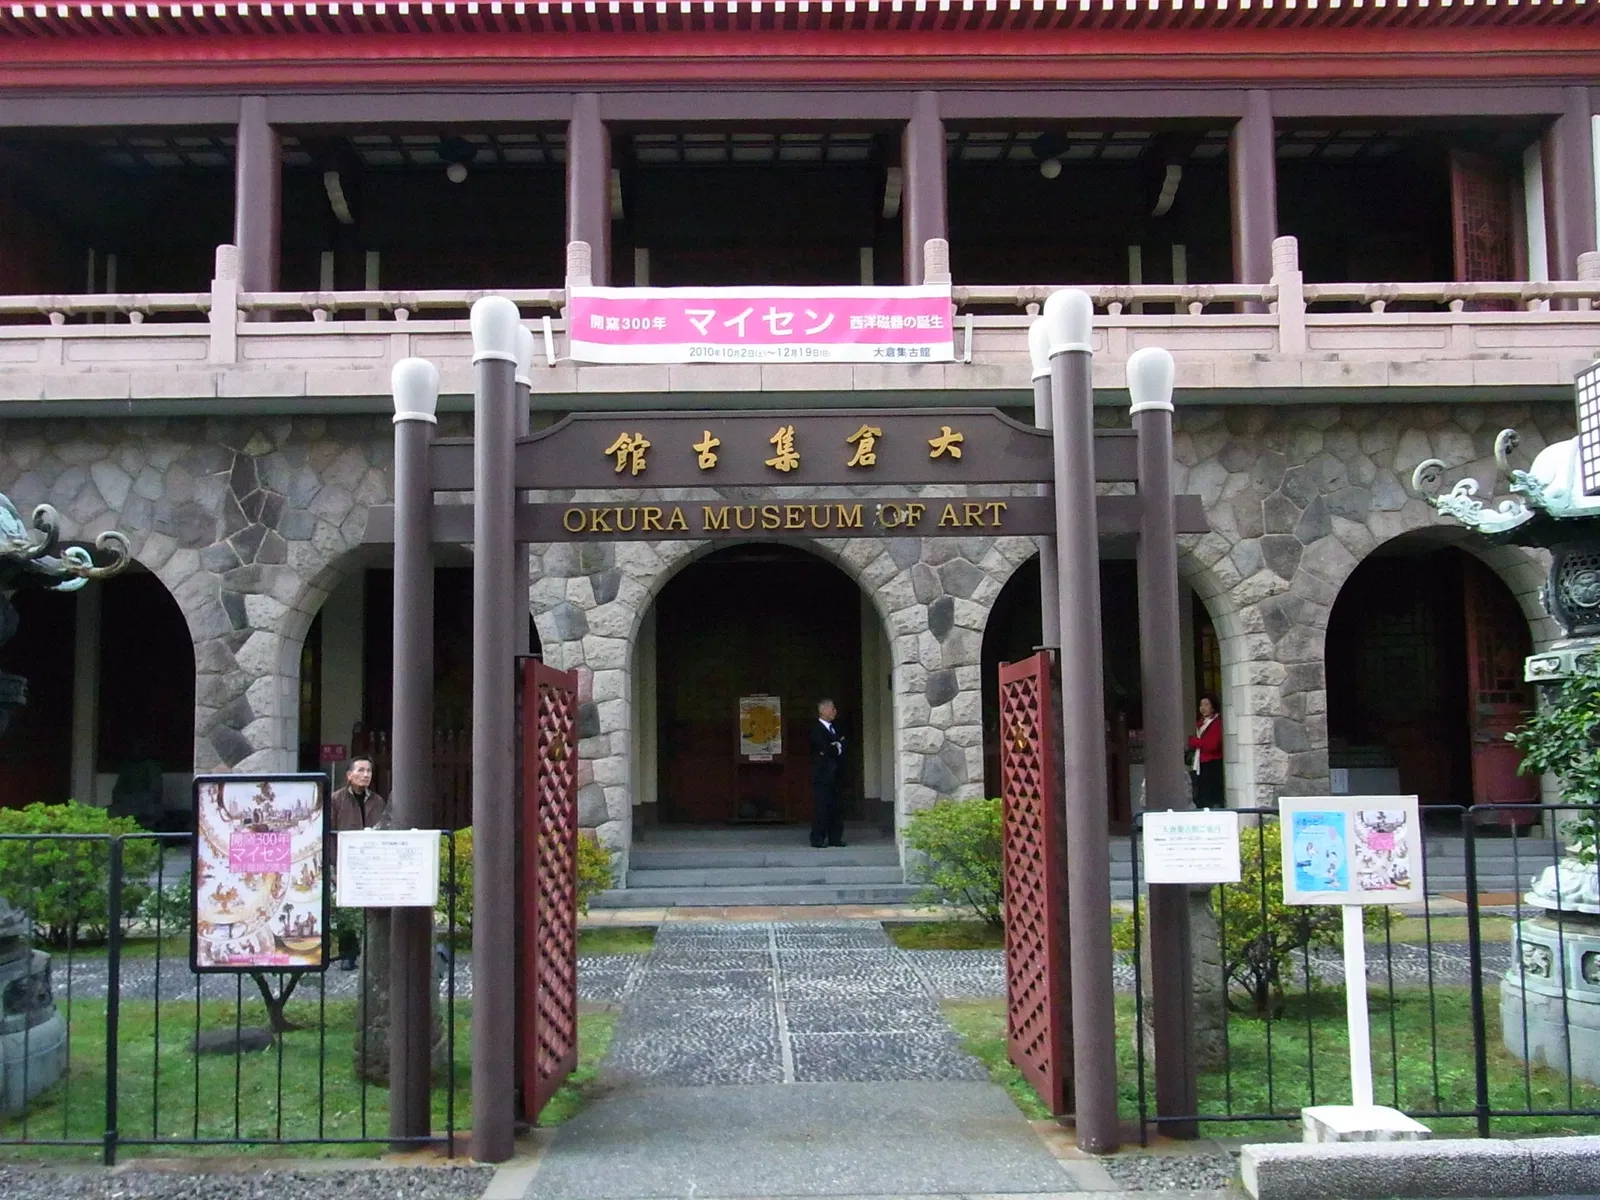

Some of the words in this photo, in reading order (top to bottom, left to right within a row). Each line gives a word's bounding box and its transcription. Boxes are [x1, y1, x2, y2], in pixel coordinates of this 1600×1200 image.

[590, 314, 667, 331] 開窯300年
[684, 307, 835, 338] マイセン
[849, 315, 944, 329] 西洋磁器の誕生
[873, 347, 932, 358] 大倉集古館
[563, 506, 689, 533] OKURA
[703, 504, 864, 530] MUSEUM
[878, 502, 926, 528] OF
[938, 502, 1008, 528] ART
[231, 847, 289, 862] マイセン
